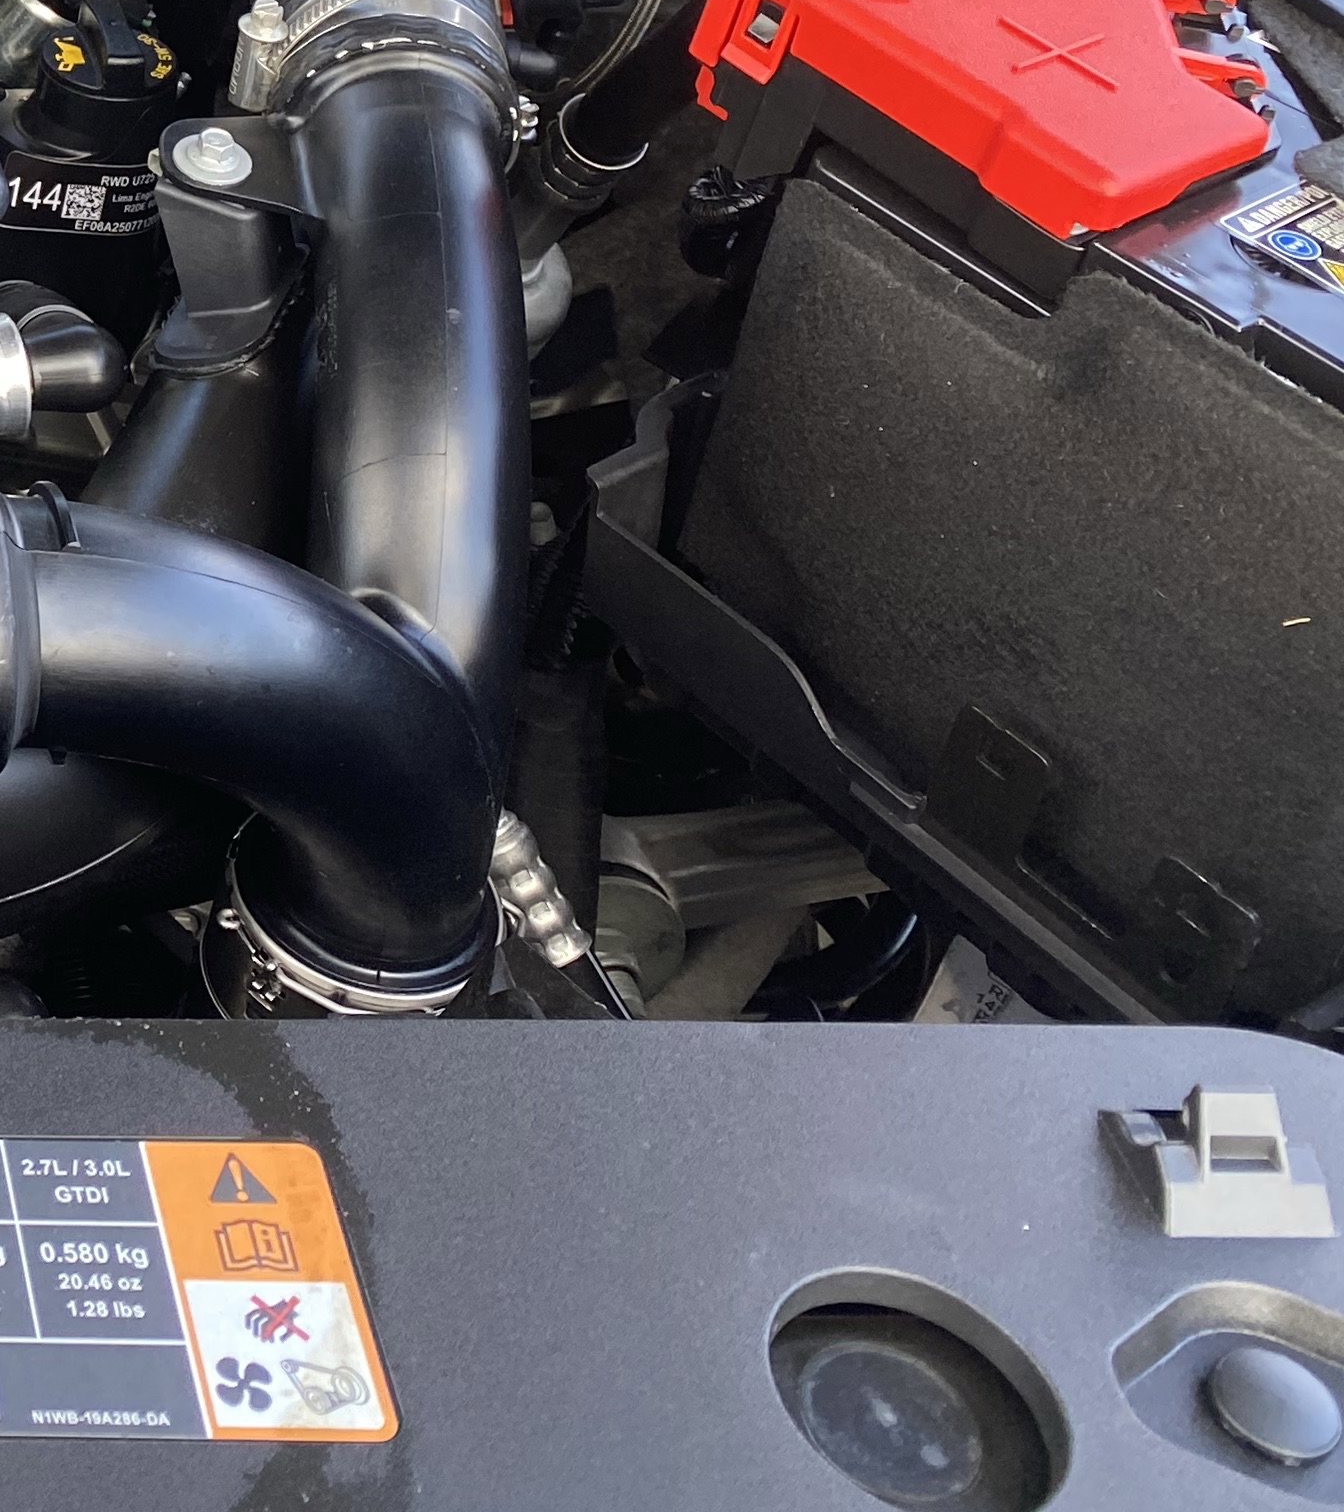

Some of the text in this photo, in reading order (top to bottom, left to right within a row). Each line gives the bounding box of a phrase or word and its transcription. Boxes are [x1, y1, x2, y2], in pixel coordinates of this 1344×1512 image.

[100, 175, 130, 188] RWD
[20, 1158, 131, 1177] 2.7L / 3.0L
[54, 1185, 110, 1204] GTDI
[39, 1241, 149, 1269] 0.580 kg
[57, 1272, 144, 1292] 20.46 oz
[66, 1300, 146, 1319] 1.28 lbs
